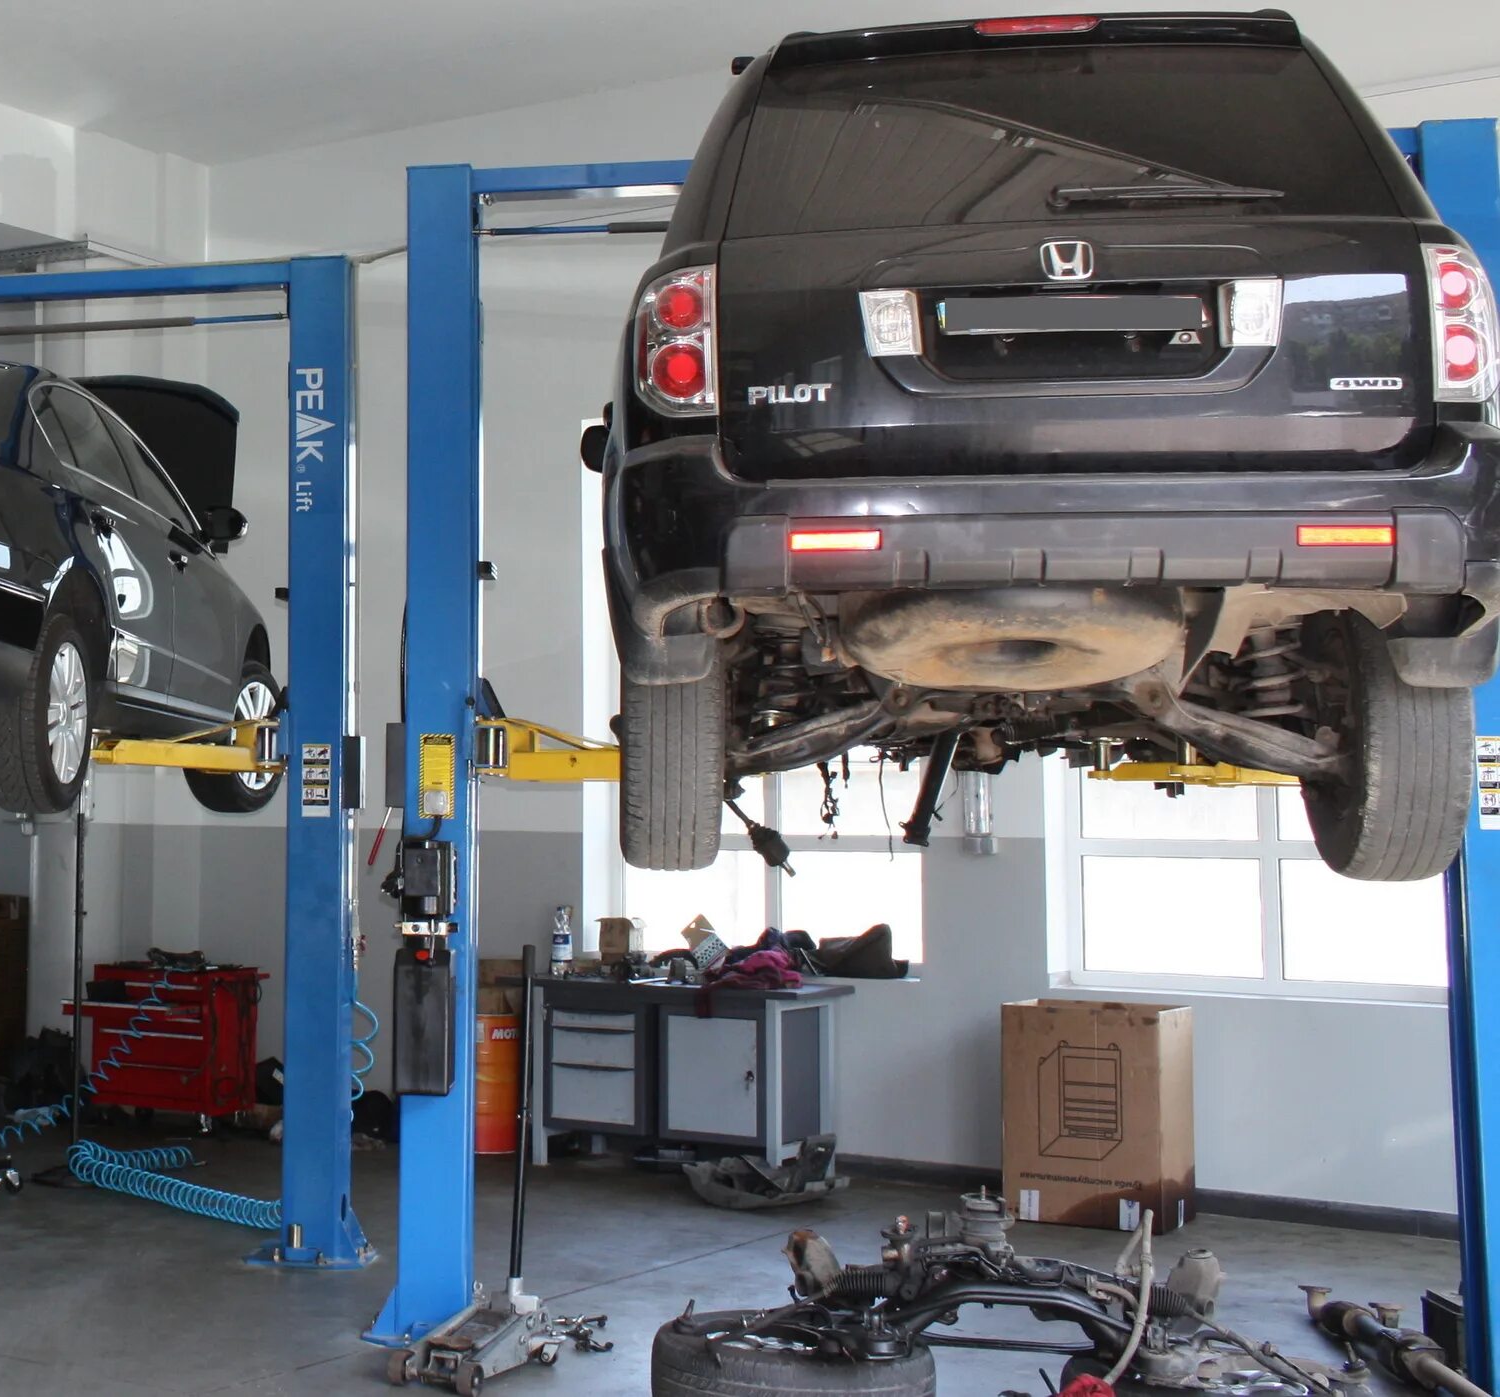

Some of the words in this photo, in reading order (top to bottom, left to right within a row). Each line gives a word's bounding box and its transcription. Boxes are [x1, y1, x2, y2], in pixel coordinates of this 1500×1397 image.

[748, 383, 832, 405] PILOT
[1333, 378, 1400, 389] 4WD
[296, 368, 336, 463] PEAK
[296, 481, 313, 512] Lift
